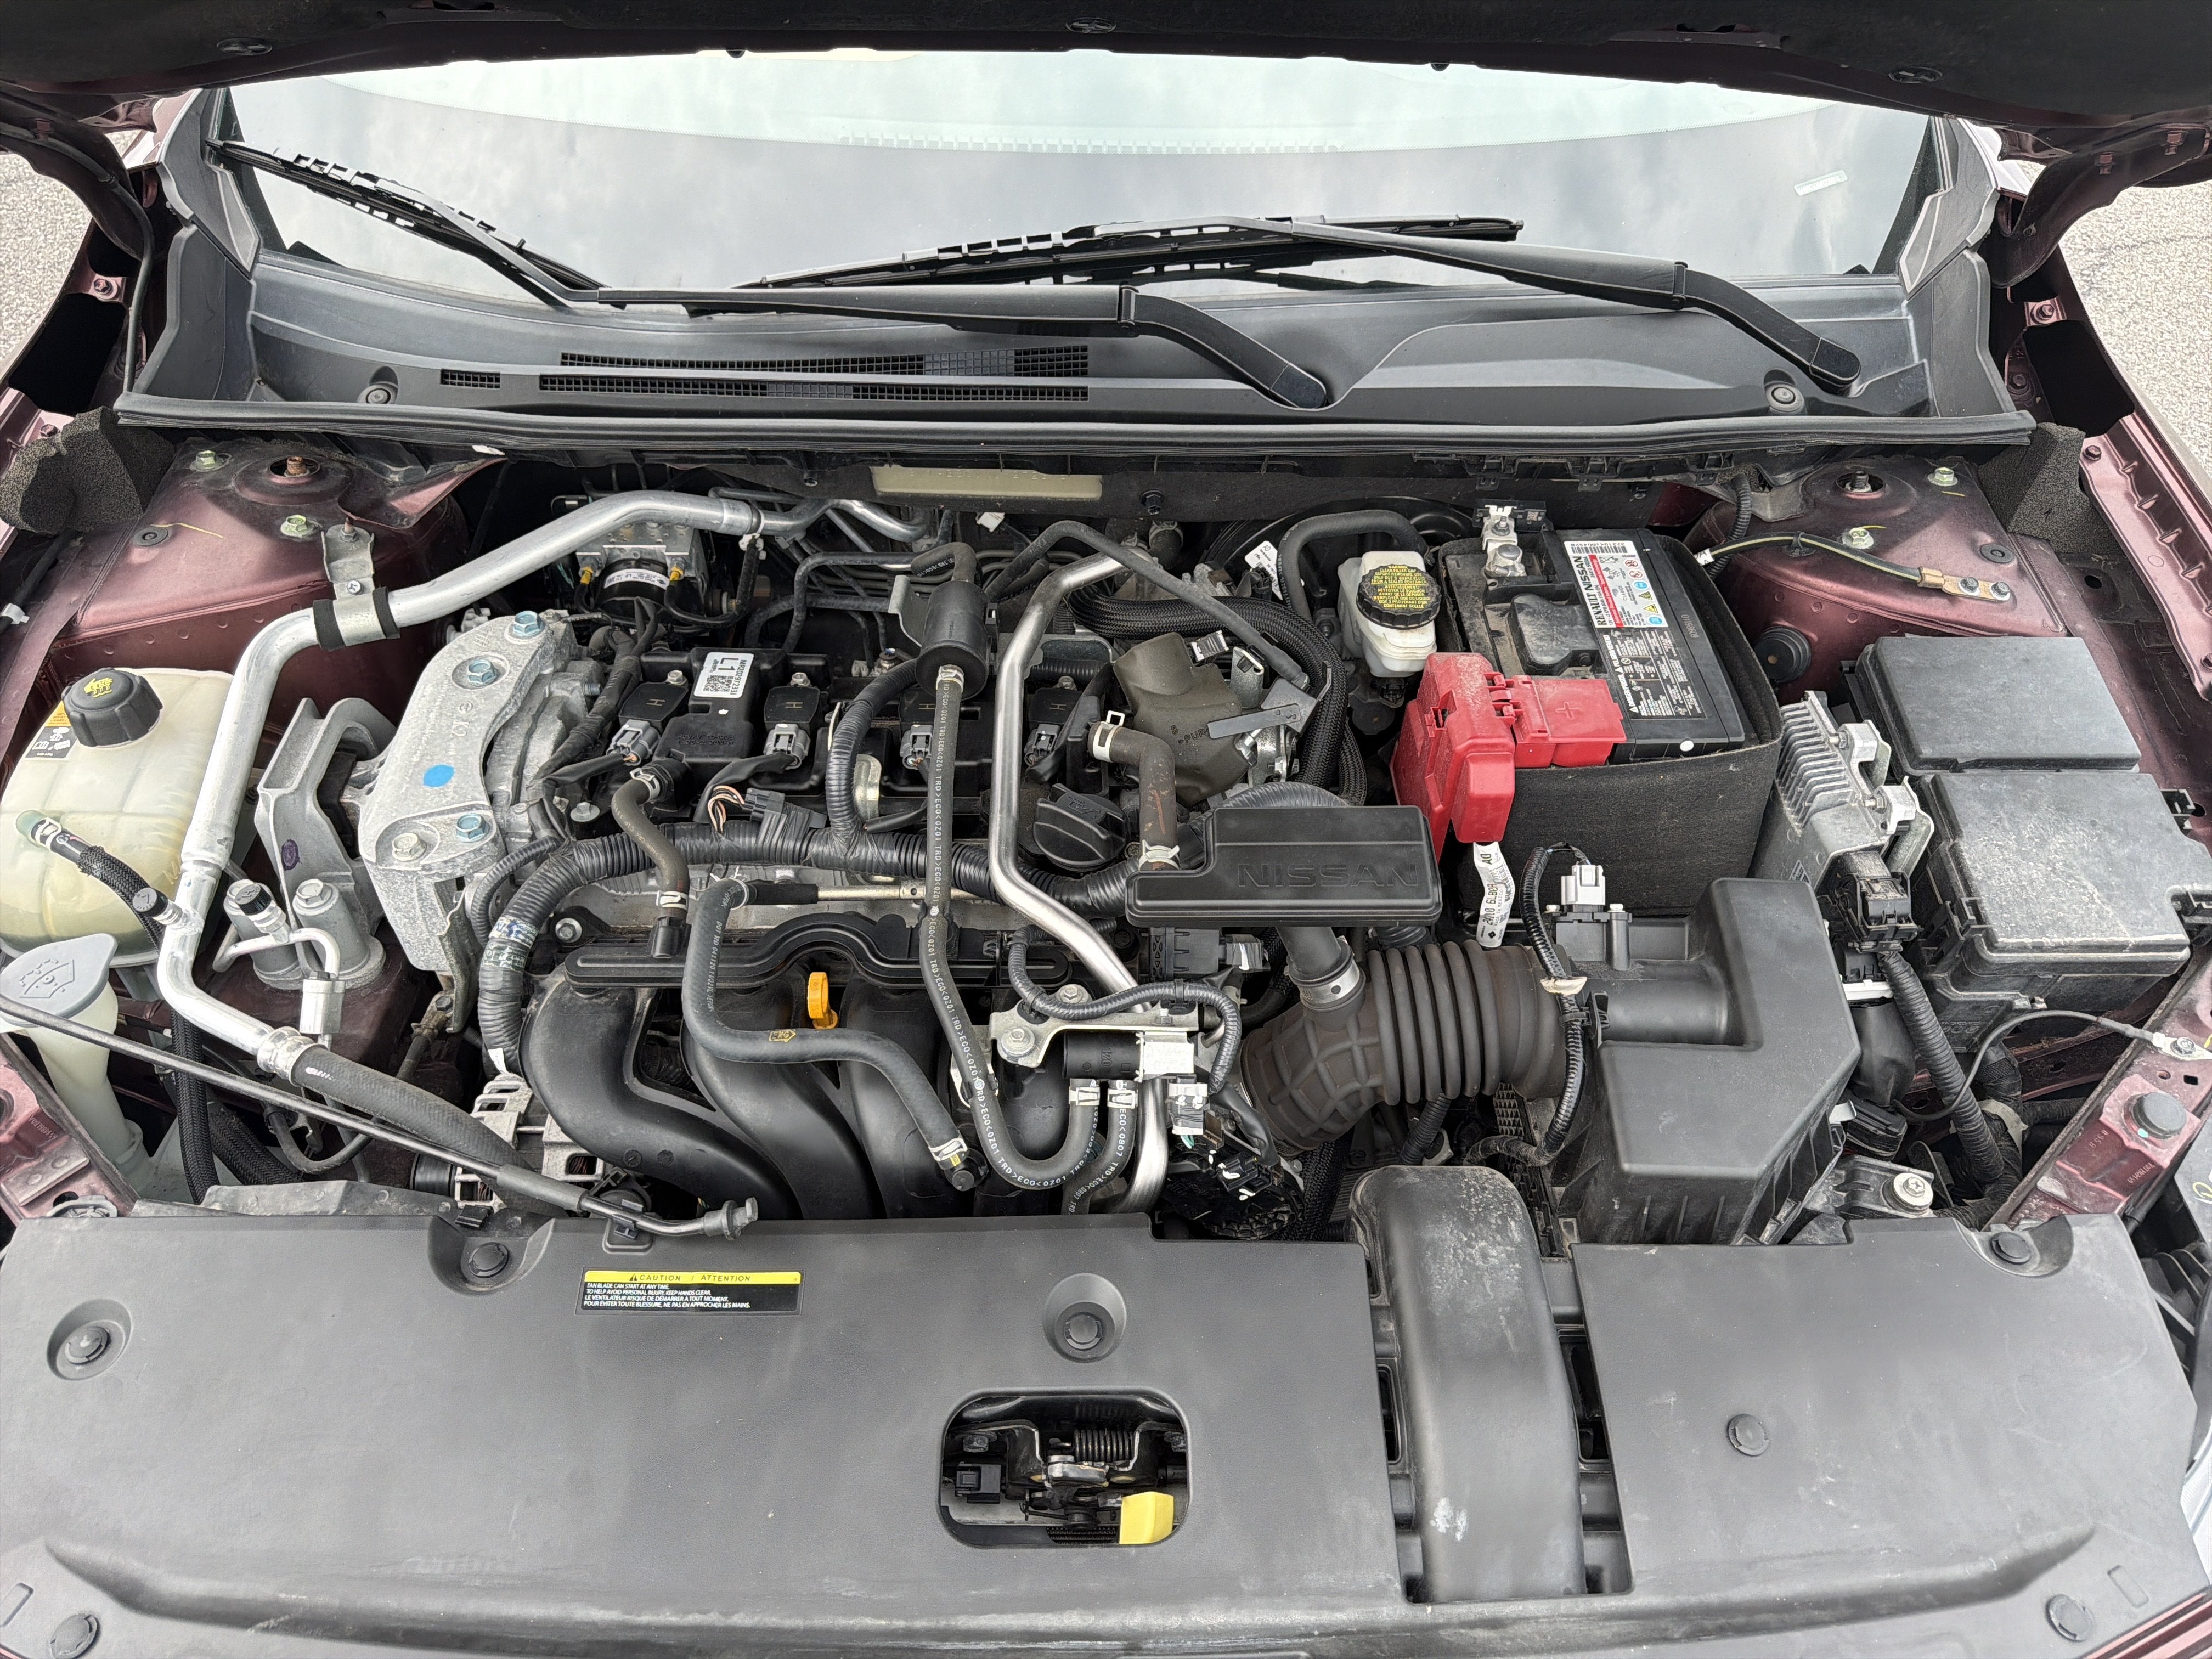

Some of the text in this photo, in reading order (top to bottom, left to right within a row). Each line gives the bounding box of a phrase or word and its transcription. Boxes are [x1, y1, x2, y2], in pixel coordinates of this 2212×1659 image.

[1572, 556, 1607, 625] RENAULT NISSAN
[1617, 585, 1628, 600] CLARIOS
[718, 658, 739, 670] L1
[730, 659, 747, 695] MR20297233J
[1238, 864, 1419, 888] NISSAN
[715, 921, 723, 934] DOT
